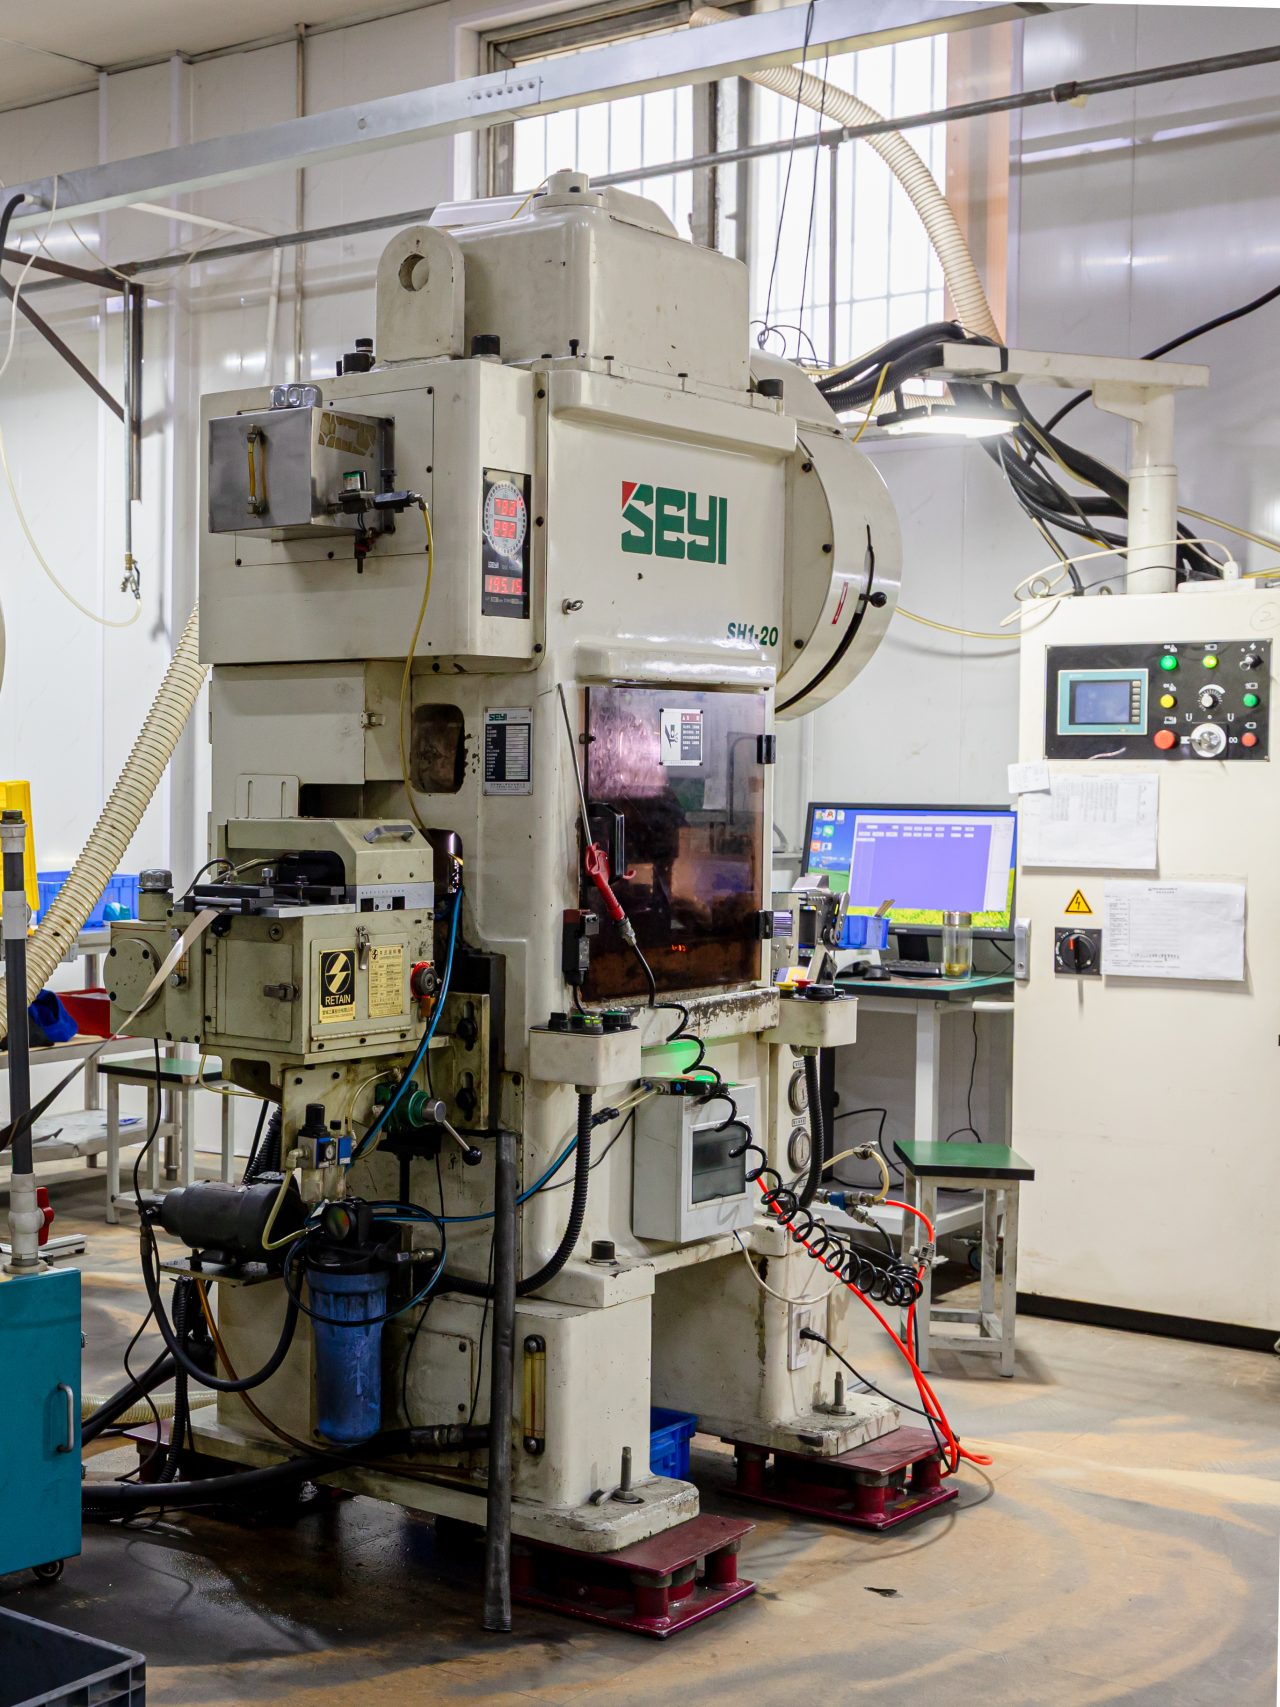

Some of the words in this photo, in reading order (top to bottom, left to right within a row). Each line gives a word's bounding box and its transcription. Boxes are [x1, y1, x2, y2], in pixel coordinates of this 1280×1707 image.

[621, 481, 728, 565] SEYI
[727, 622, 779, 647] SH1-20
[325, 995, 351, 1006] RETAIN
